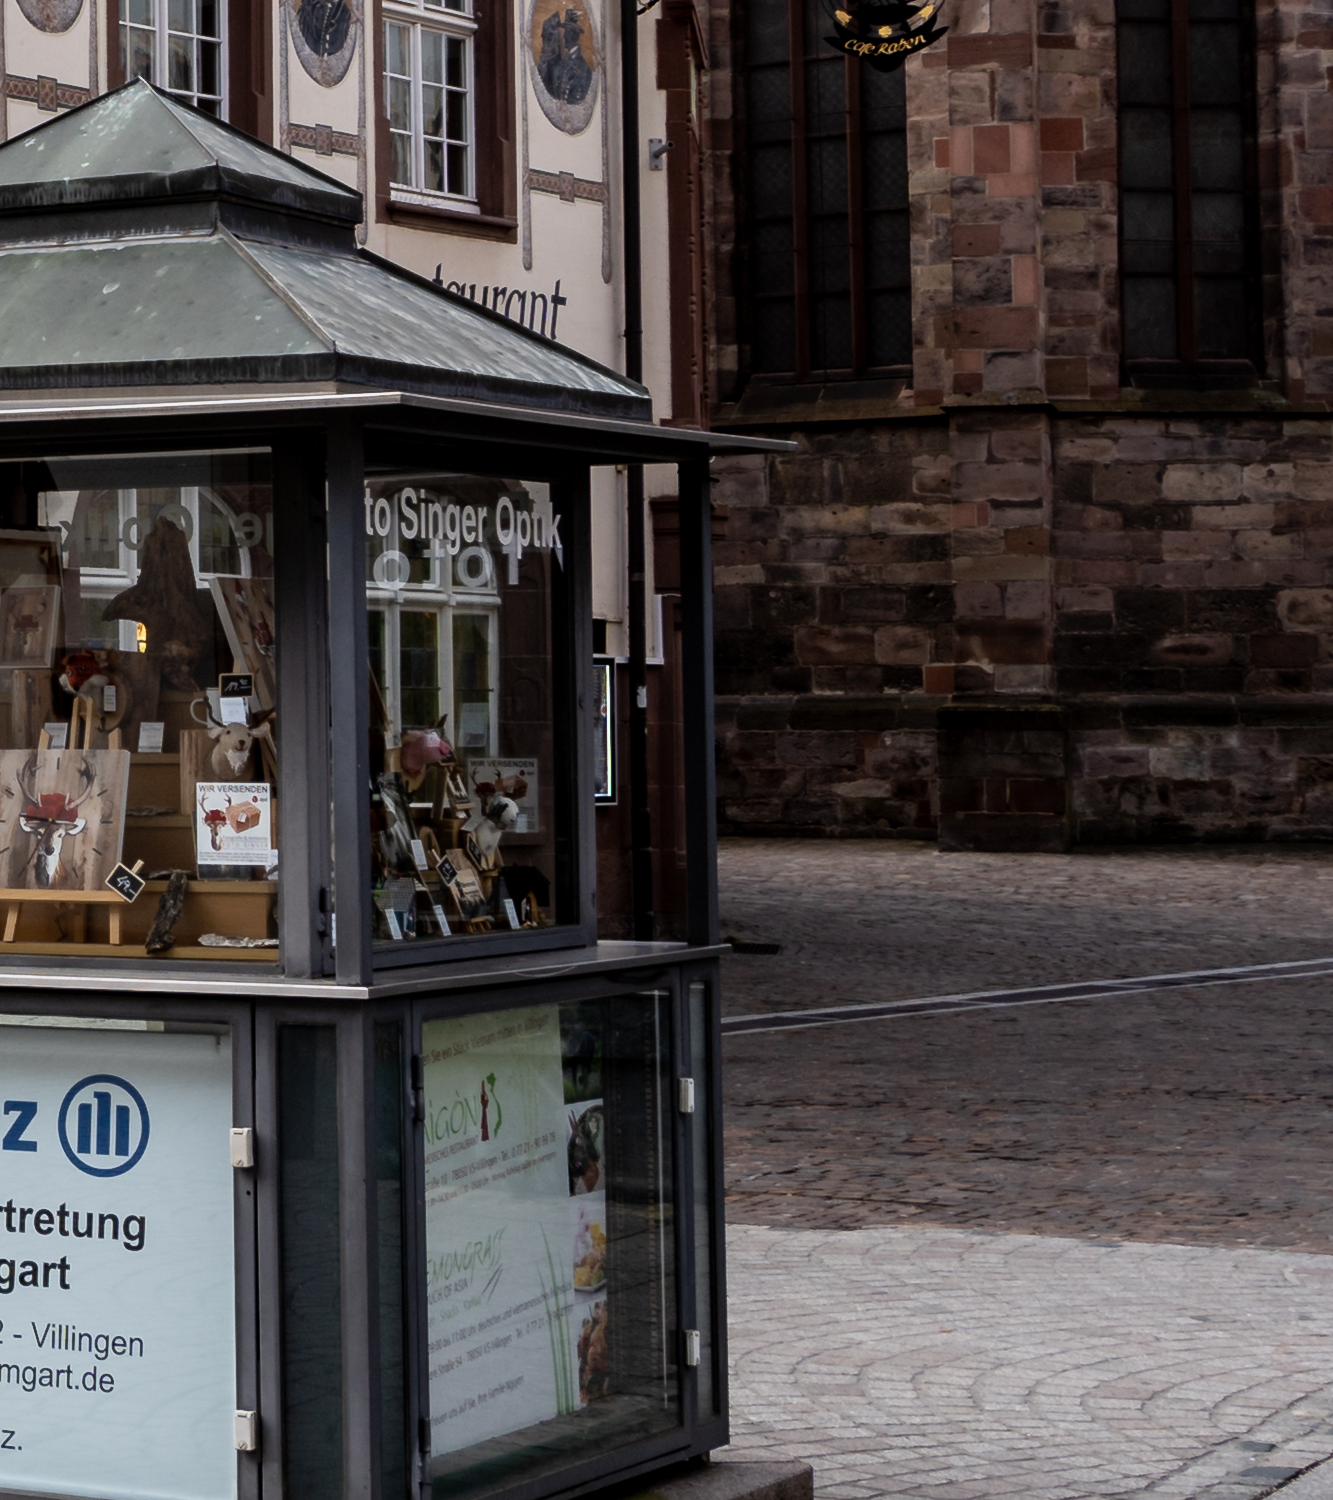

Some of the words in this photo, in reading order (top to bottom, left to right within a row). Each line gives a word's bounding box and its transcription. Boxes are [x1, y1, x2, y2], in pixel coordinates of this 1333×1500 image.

[401, 487, 487, 555] Singer
[496, 496, 561, 559] Optik
[198, 784, 215, 793] WIR
[217, 784, 268, 794] VERSENDEN
[31, 1321, 144, 1360] Villingen
